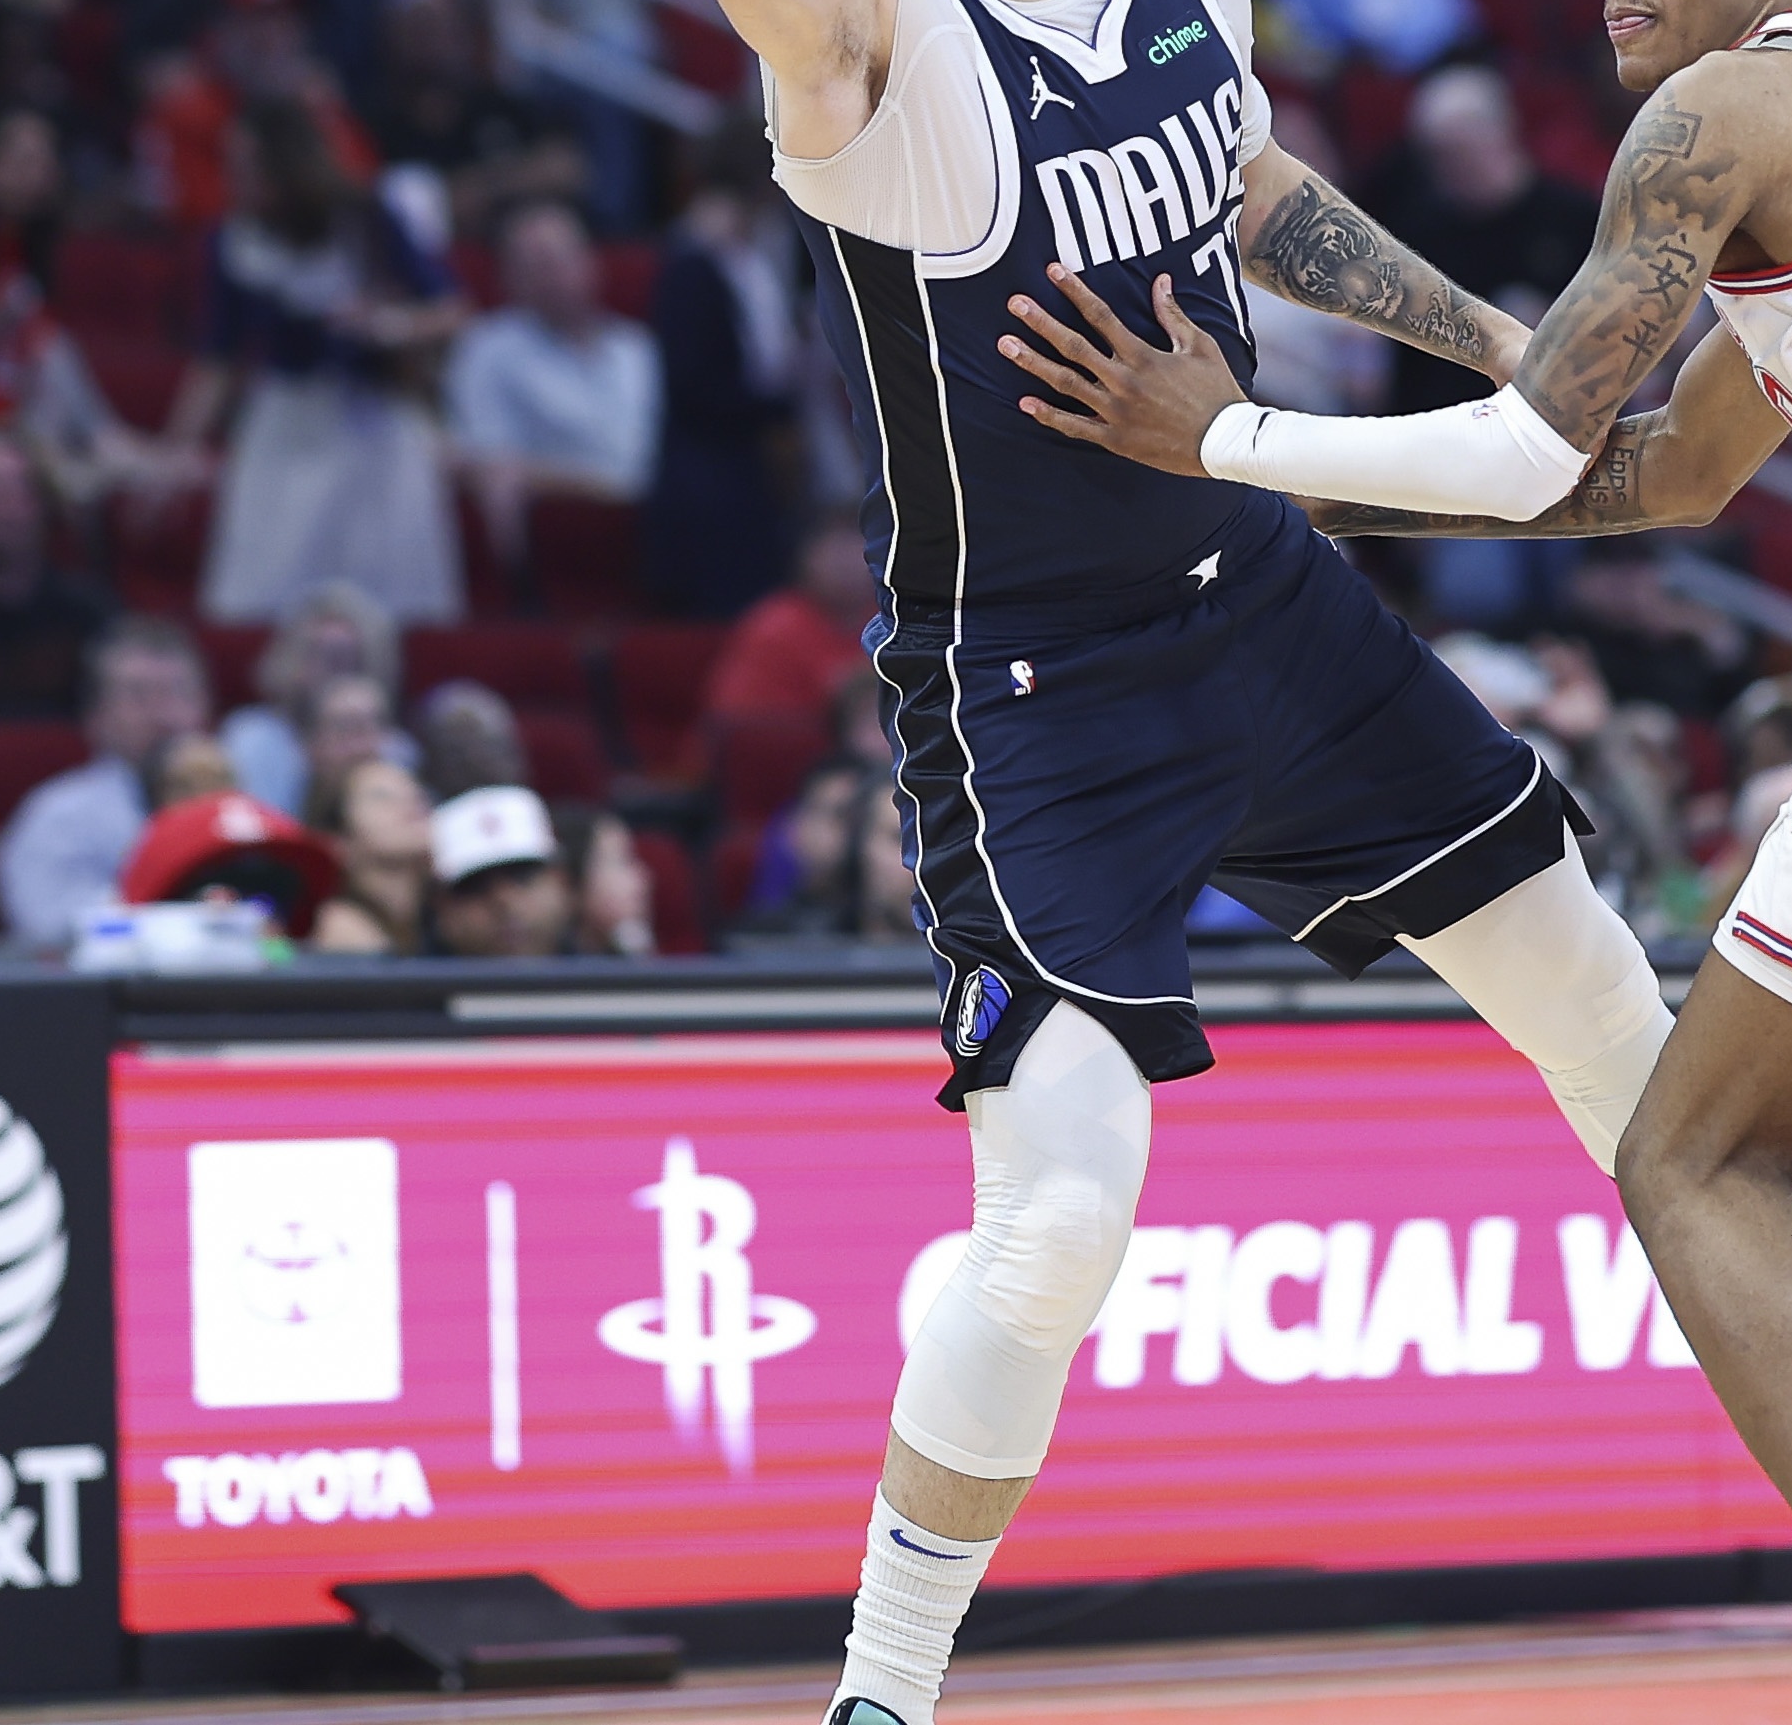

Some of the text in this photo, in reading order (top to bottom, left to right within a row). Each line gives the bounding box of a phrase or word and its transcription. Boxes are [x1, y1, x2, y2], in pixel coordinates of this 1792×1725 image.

[1148, 19, 1208, 66] chime
[1035, 77, 1245, 274] MAVS
[898, 1214, 1544, 1390] FICIAL
[162, 1447, 434, 1527] TOYOTA
